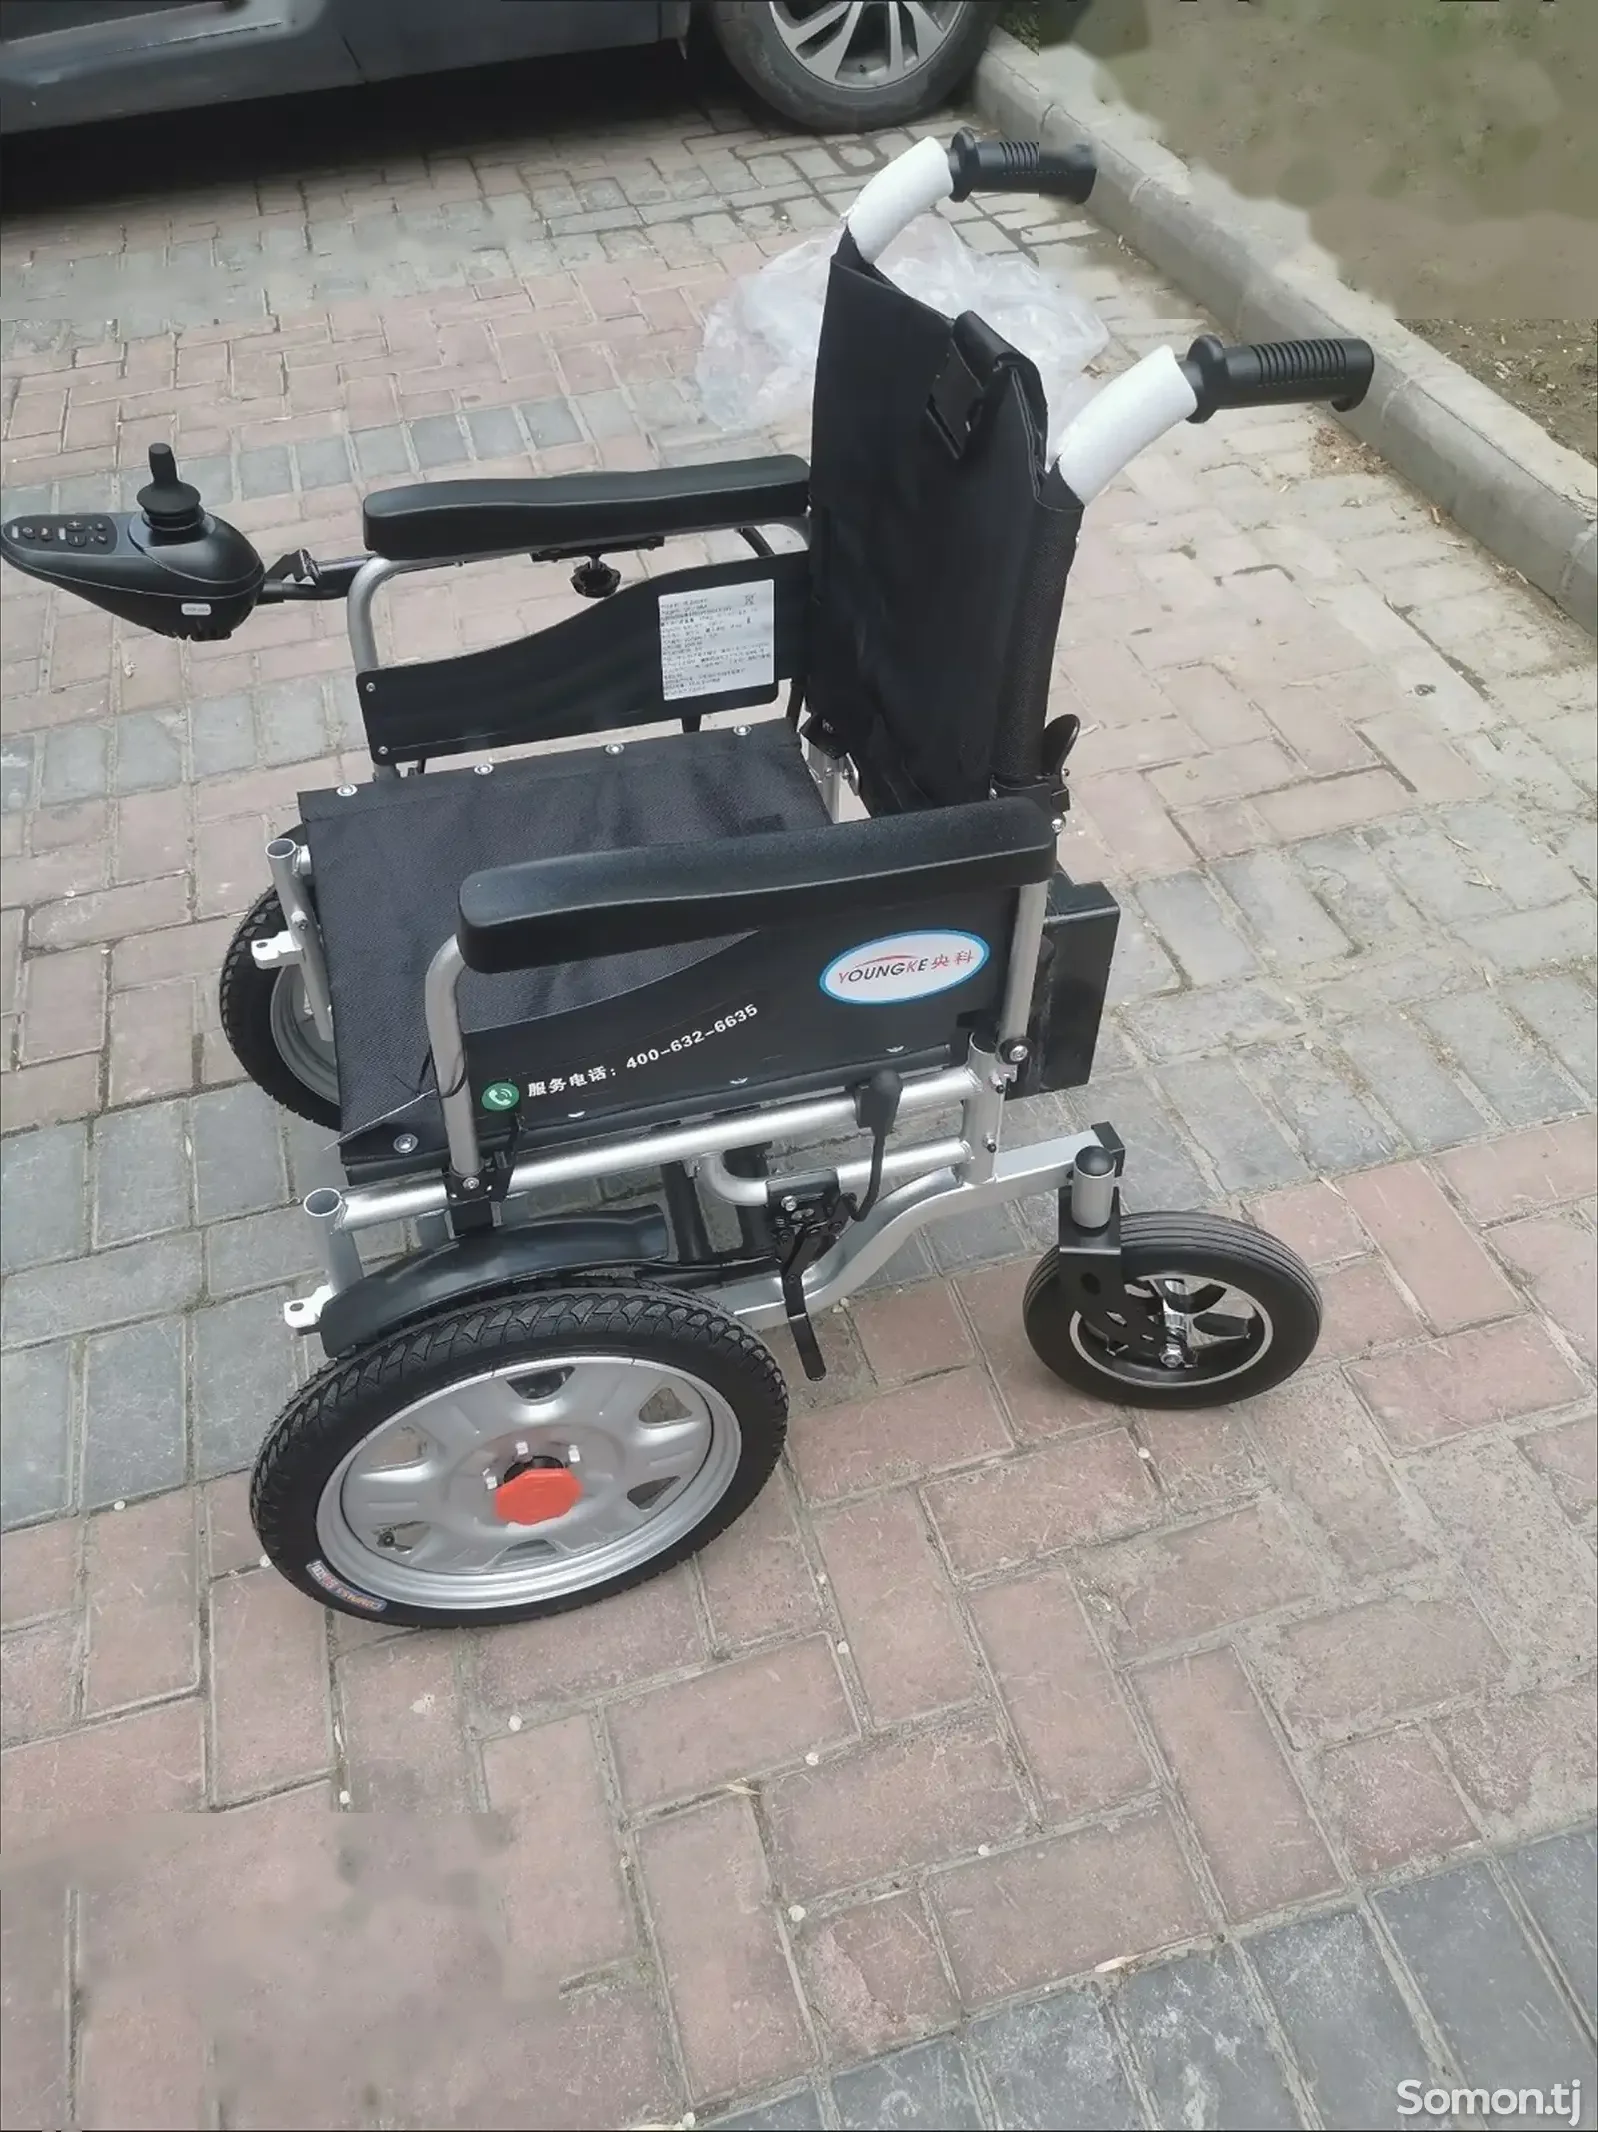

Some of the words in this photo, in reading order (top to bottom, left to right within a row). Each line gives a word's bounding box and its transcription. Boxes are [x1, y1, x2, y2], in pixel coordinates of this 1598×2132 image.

[838, 957, 929, 984] YOUNGKE
[930, 949, 974, 970] 央科
[625, 1003, 759, 1070] 400-632-6635
